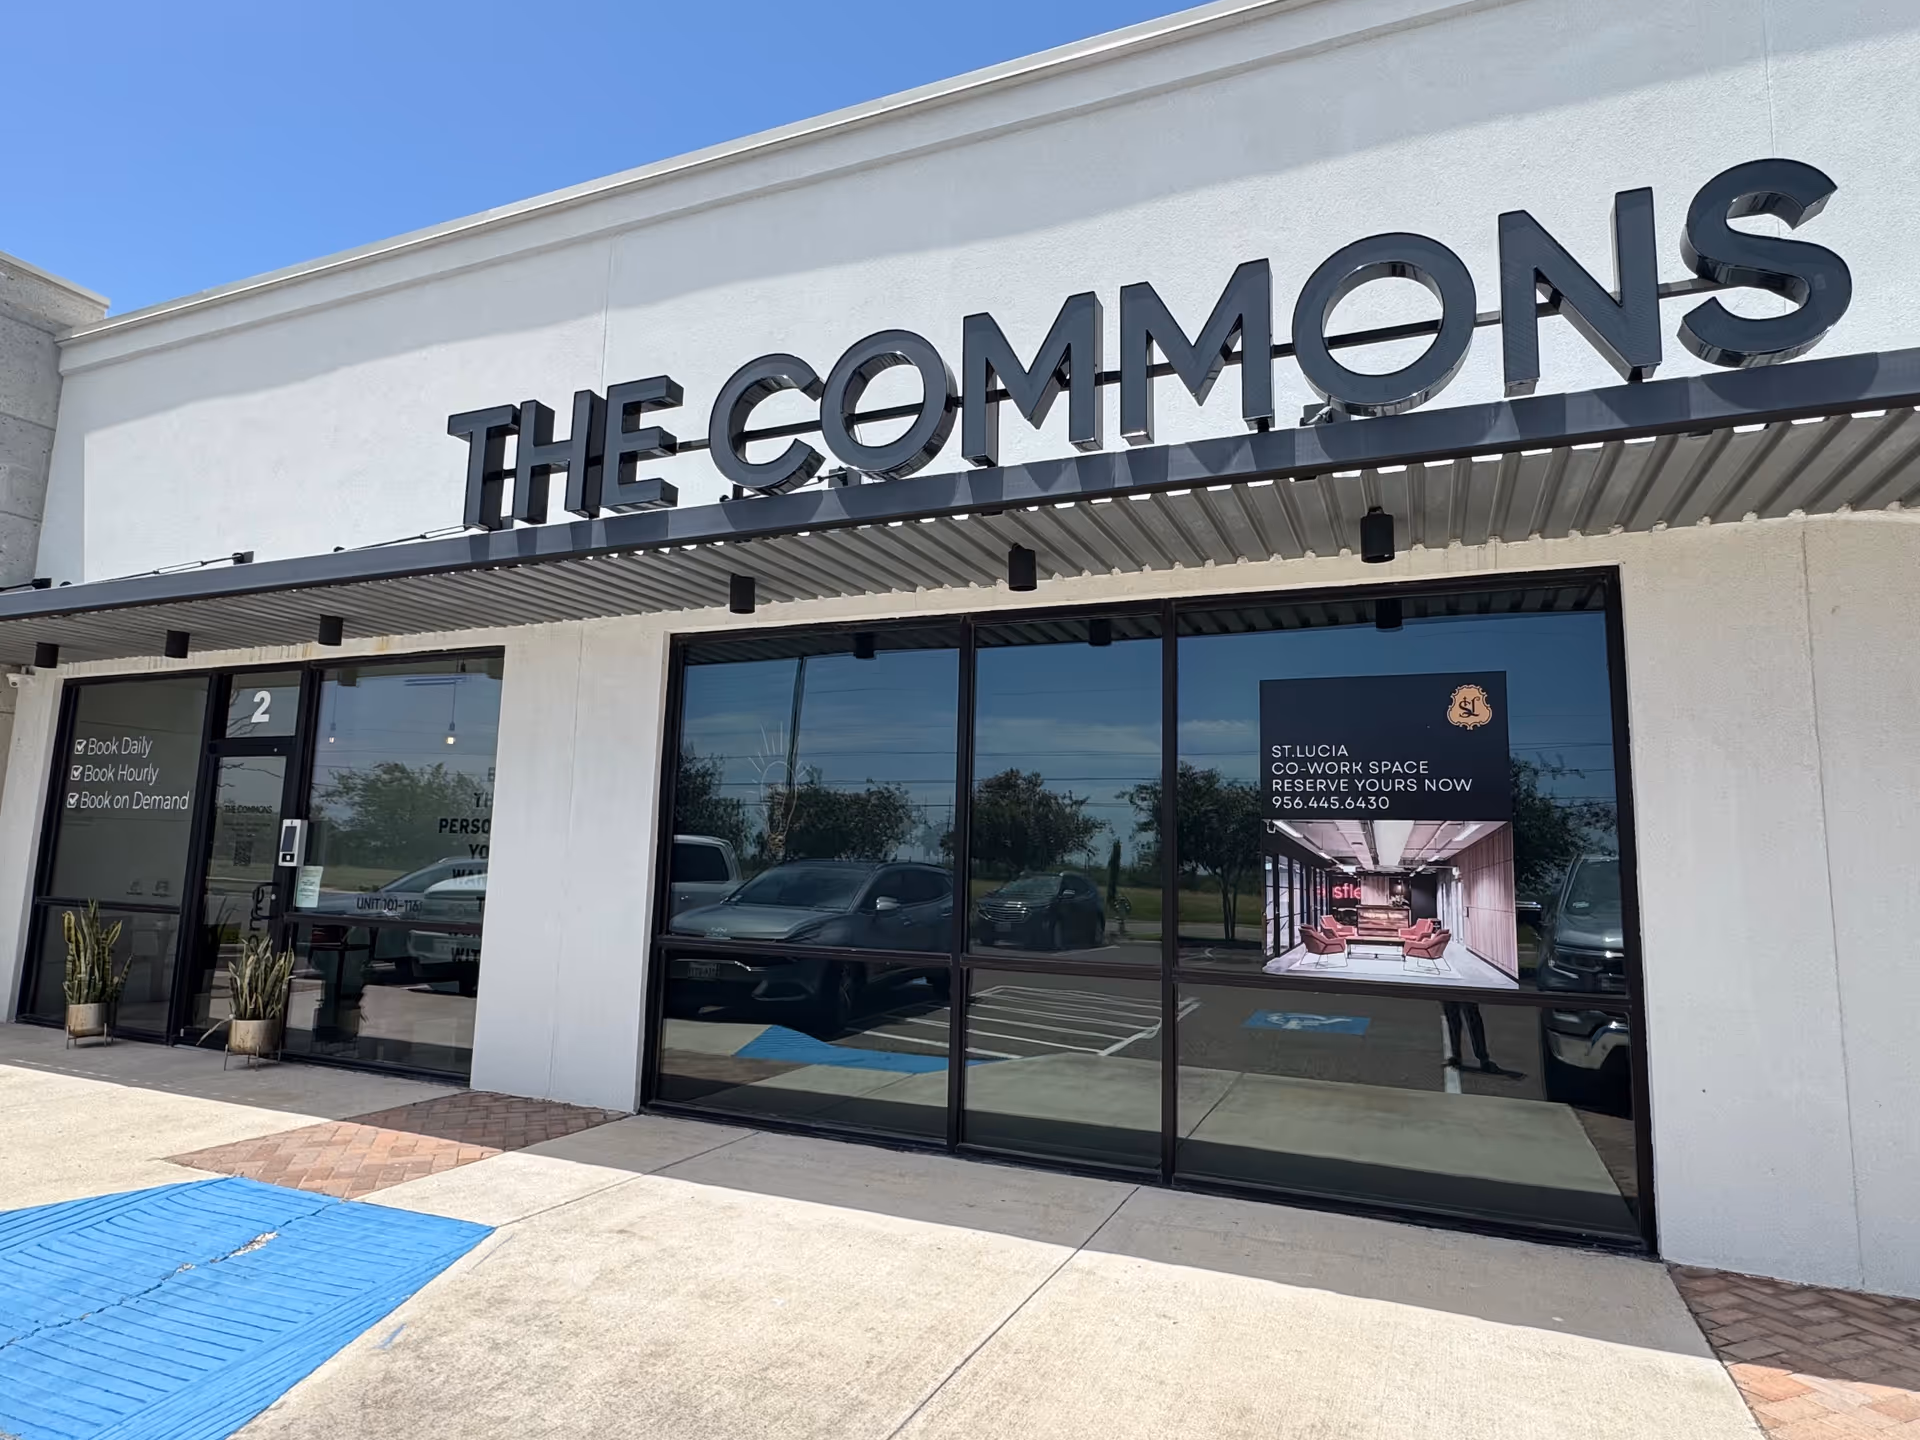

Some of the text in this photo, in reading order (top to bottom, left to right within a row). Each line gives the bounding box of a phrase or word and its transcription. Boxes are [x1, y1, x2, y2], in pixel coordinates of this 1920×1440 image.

[448, 158, 1852, 531] THE COMMONS
[251, 690, 271, 723] 2
[87, 736, 153, 758] Book Daily
[1271, 744, 1349, 758] ST.LUCIA
[84, 763, 159, 786] Book Hourly
[1271, 760, 1429, 775] CO-WORK SPACE
[1272, 778, 1473, 792] RESERVE YOURS NOW
[80, 791, 190, 810] Book on Demand
[474, 792, 493, 808] TH
[1272, 796, 1389, 809] 956.445.6430
[439, 818, 491, 834] PERSO
[468, 844, 489, 859] YO
[356, 897, 381, 910] UNIT
